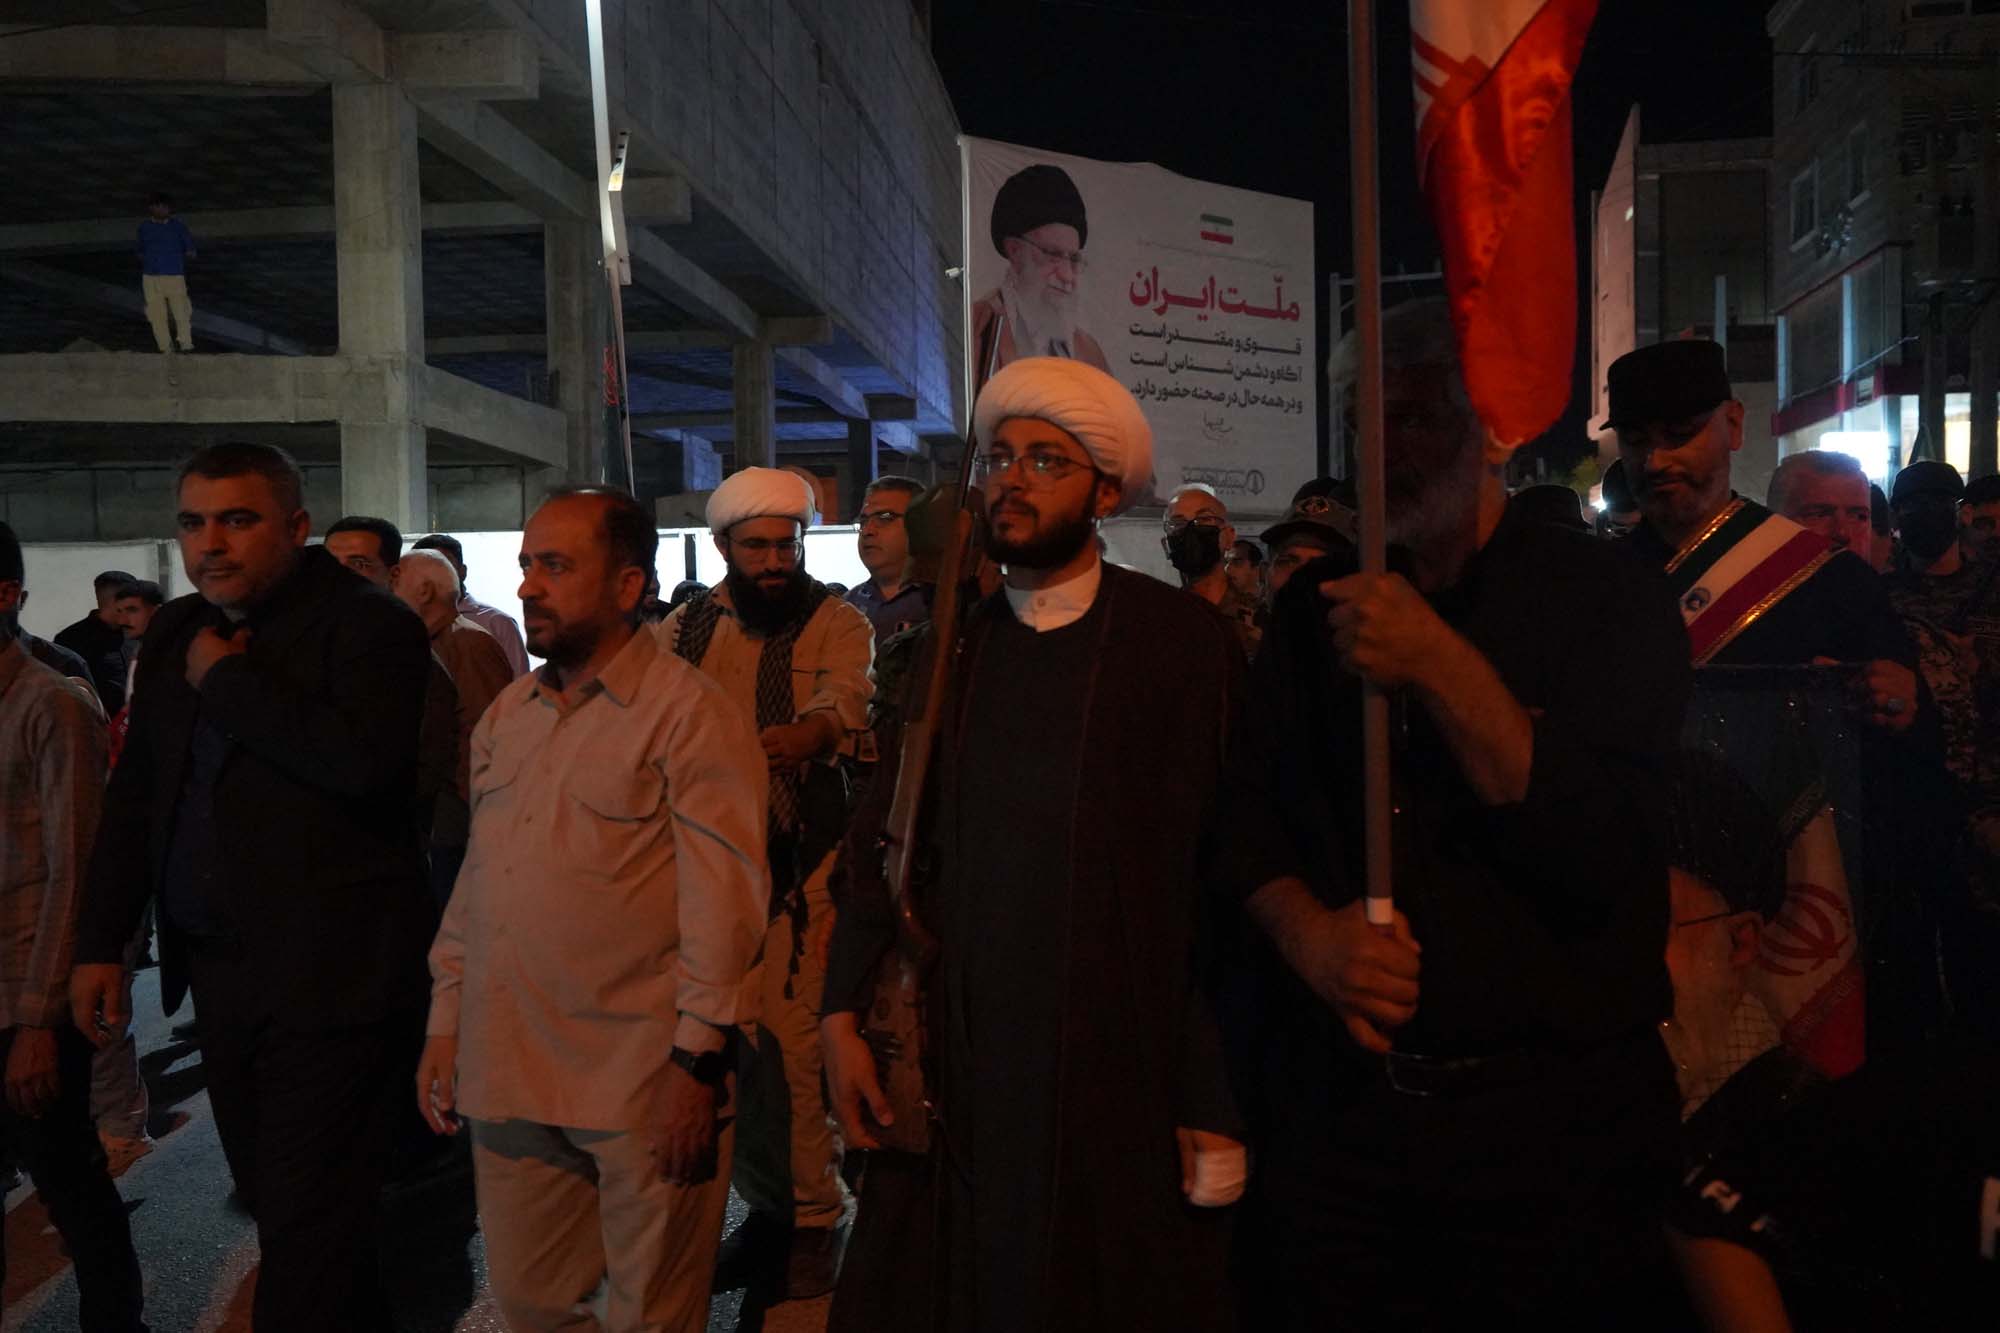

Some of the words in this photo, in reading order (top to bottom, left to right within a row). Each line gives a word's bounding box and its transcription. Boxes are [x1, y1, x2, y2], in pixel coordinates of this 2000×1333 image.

[1129, 266, 1216, 321] ایران
[1129, 323, 1166, 338] است
[1166, 329, 1234, 347] مقتدر
[1235, 339, 1241, 353] و
[1129, 352, 1168, 366] است
[1276, 365, 1303, 382] آگاه
[1156, 383, 1191, 401] حضور
[1192, 387, 1225, 402] صحنه
[1238, 388, 1260, 408] حال
[1226, 392, 1238, 408] در
[1262, 394, 1284, 408] همه
[1284, 399, 1296, 413] در
[1297, 400, 1303, 414] و
